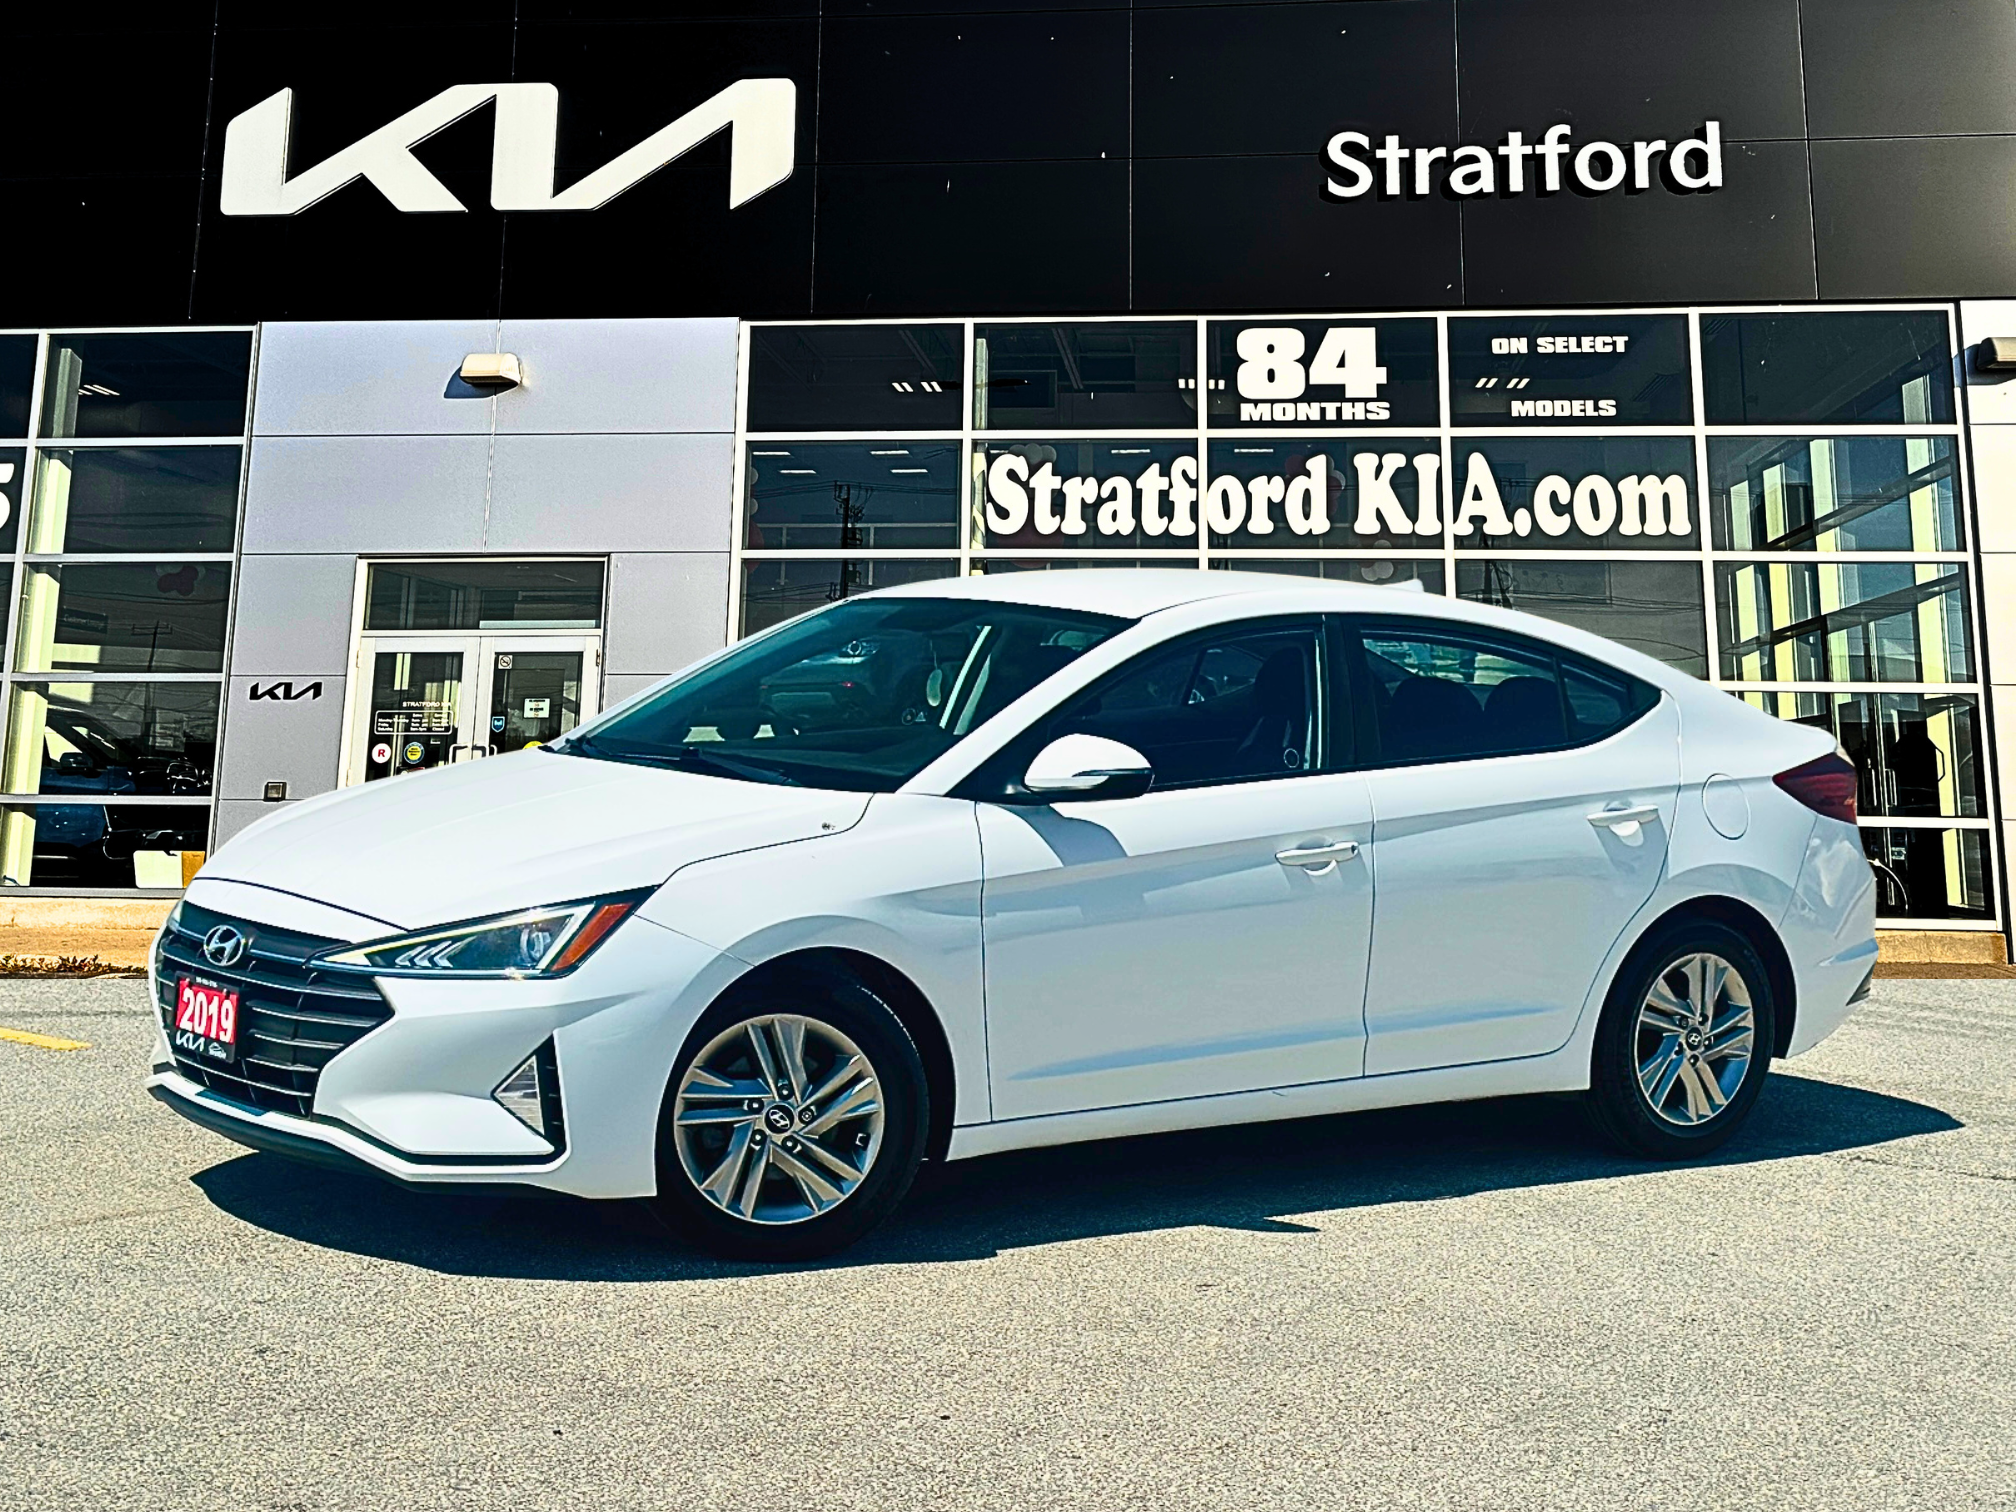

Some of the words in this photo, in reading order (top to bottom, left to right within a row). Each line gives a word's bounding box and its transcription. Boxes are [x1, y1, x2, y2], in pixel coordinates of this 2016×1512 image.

[220, 78, 796, 216] KIA
[1326, 120, 1723, 198] Stratford
[1236, 326, 1388, 400] 84
[1491, 337, 1529, 355] ON
[1536, 335, 1629, 354] SELECT
[1239, 401, 1391, 422] MONTHS
[1510, 399, 1617, 418] MODELS
[986, 453, 1330, 538] Stratford
[1353, 452, 1692, 538] KIA.com
[249, 681, 323, 701] KIA
[377, 748, 386, 758] R
[179, 987, 234, 1043] 2019
